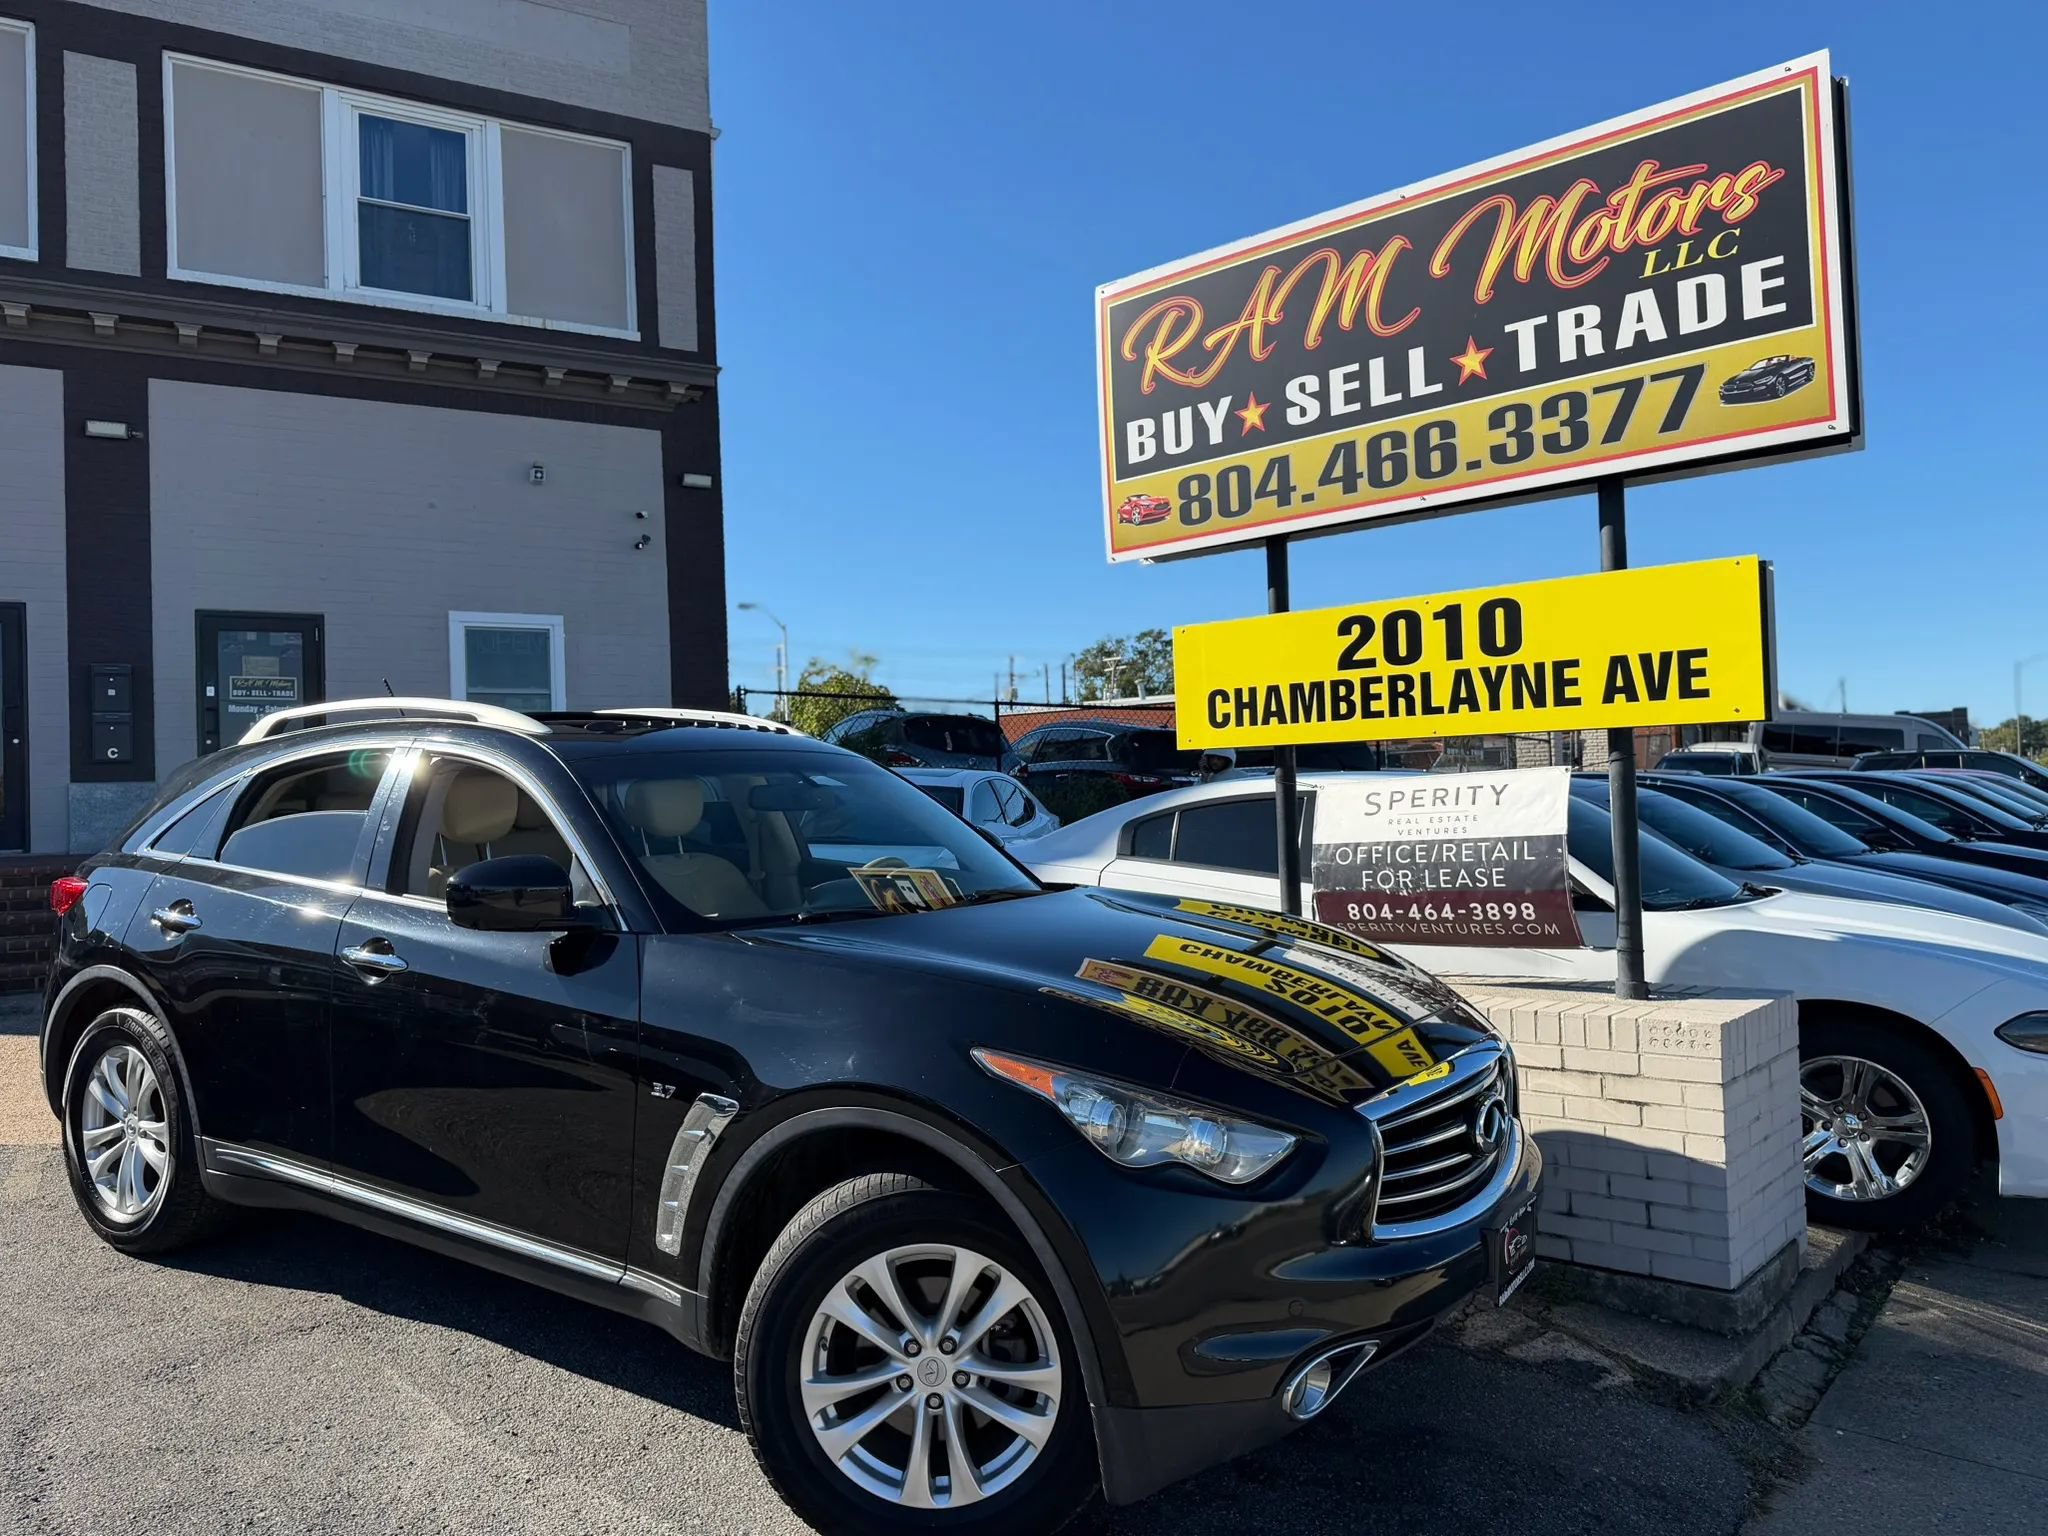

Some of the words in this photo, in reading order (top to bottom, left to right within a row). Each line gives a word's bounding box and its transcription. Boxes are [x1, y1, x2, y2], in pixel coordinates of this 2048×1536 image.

[1639, 228, 1742, 279] LLC
[1121, 235, 1421, 395] RAM
[1429, 160, 1785, 304] Motors
[1126, 396, 1233, 465] BUY
[1285, 346, 1443, 426] SELL
[1504, 255, 1787, 373] TRADE
[1177, 362, 1708, 527] 804.466.3377
[1337, 596, 1523, 672] 2010
[1207, 658, 1582, 729] CHAMBERLAYNE
[1602, 648, 1711, 705] AVE
[228, 705, 258, 713] Monday
[107, 747, 119, 759] C
[1364, 783, 1509, 816] SPERITY
[1388, 817, 1420, 825] REAL
[1429, 814, 1479, 824] ESTATE
[1397, 826, 1468, 836] VENTURES
[1335, 840, 1536, 865] OFFICE/RETAIL
[1362, 869, 1413, 889] FOR
[1425, 867, 1507, 888] LEASE
[1347, 902, 1537, 922] 804-464-3898
[1336, 922, 1561, 936] SPERITYVENTURES.COM
[123, 1017, 166, 1072] BRIDGESTONE
